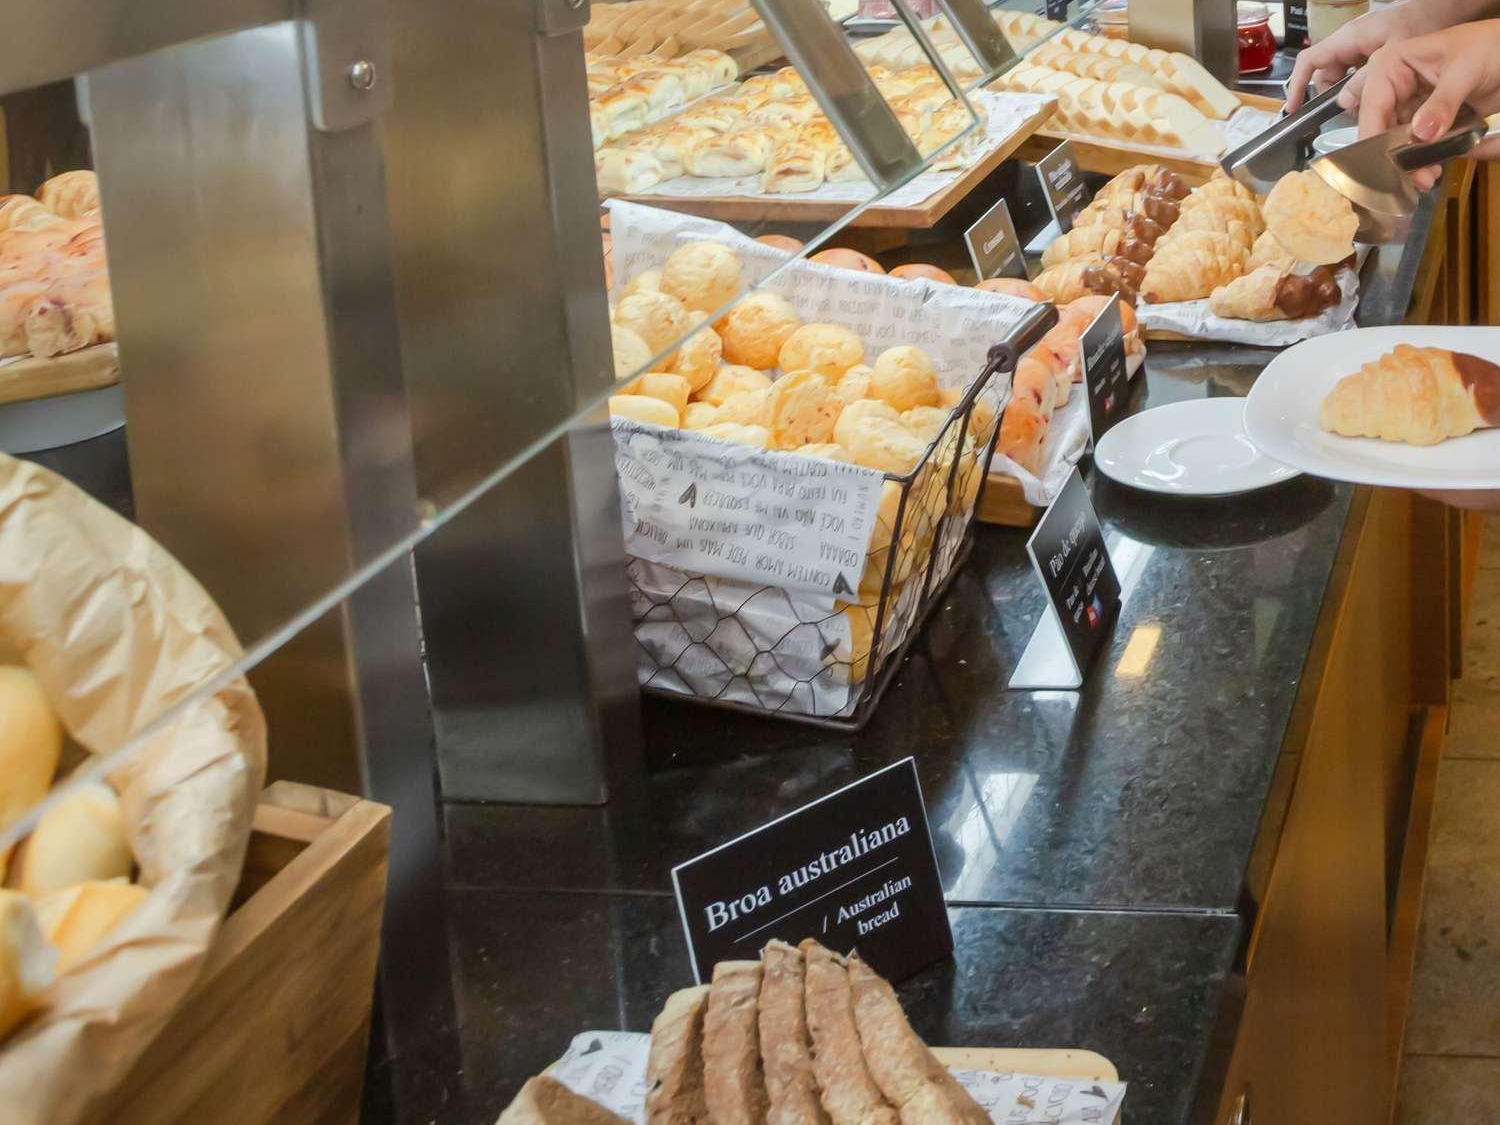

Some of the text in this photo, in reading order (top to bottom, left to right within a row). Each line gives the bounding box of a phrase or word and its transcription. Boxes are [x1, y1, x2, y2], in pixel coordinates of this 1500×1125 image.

[704, 816, 911, 933] Broa australiana
[837, 875, 912, 925] Australian
[857, 902, 900, 937] bread
